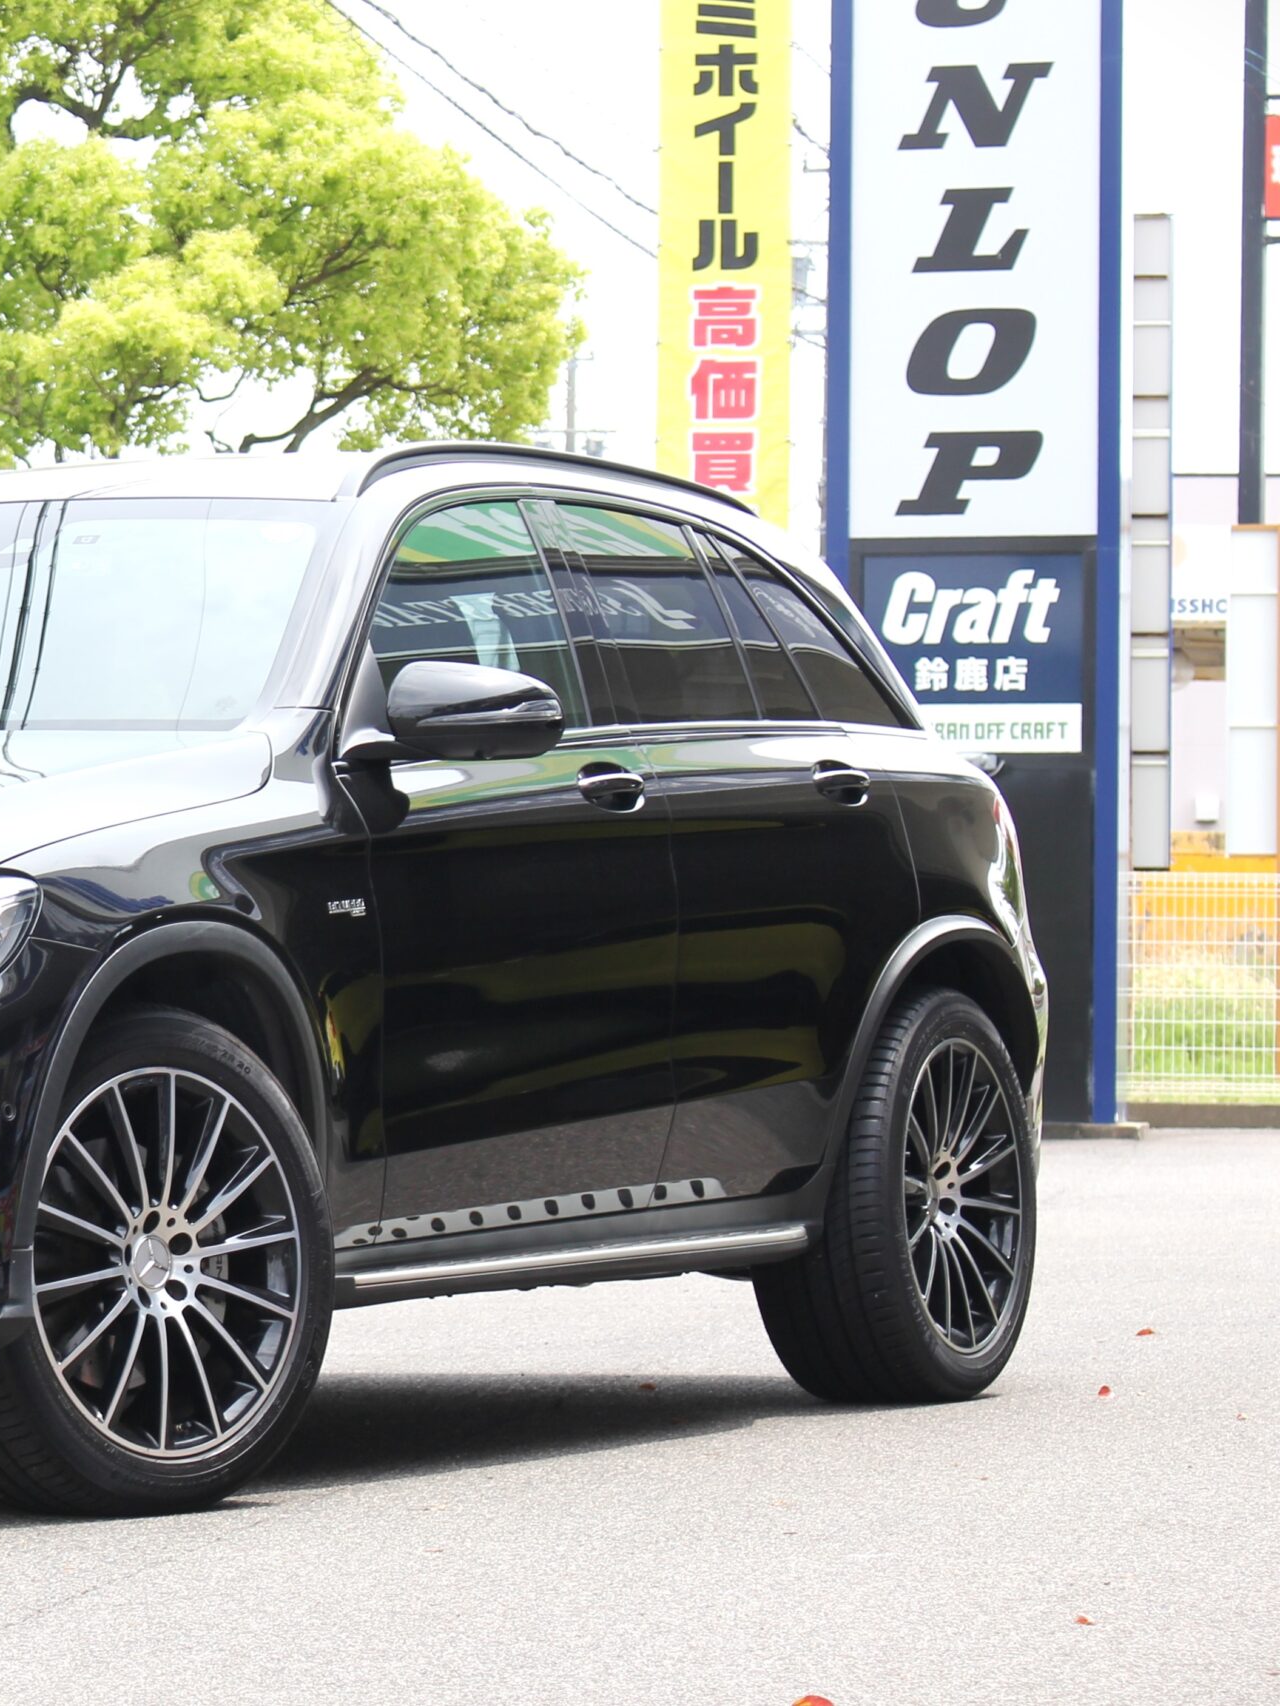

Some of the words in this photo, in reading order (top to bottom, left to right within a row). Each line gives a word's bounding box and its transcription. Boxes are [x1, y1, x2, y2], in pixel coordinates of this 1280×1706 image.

[881, 568, 1061, 646] Craft
[914, 656, 1029, 692] 鈴鹿店
[931, 721, 970, 741] RAN
[974, 721, 1006, 741] OFF
[1009, 720, 1069, 741] CRAFT
